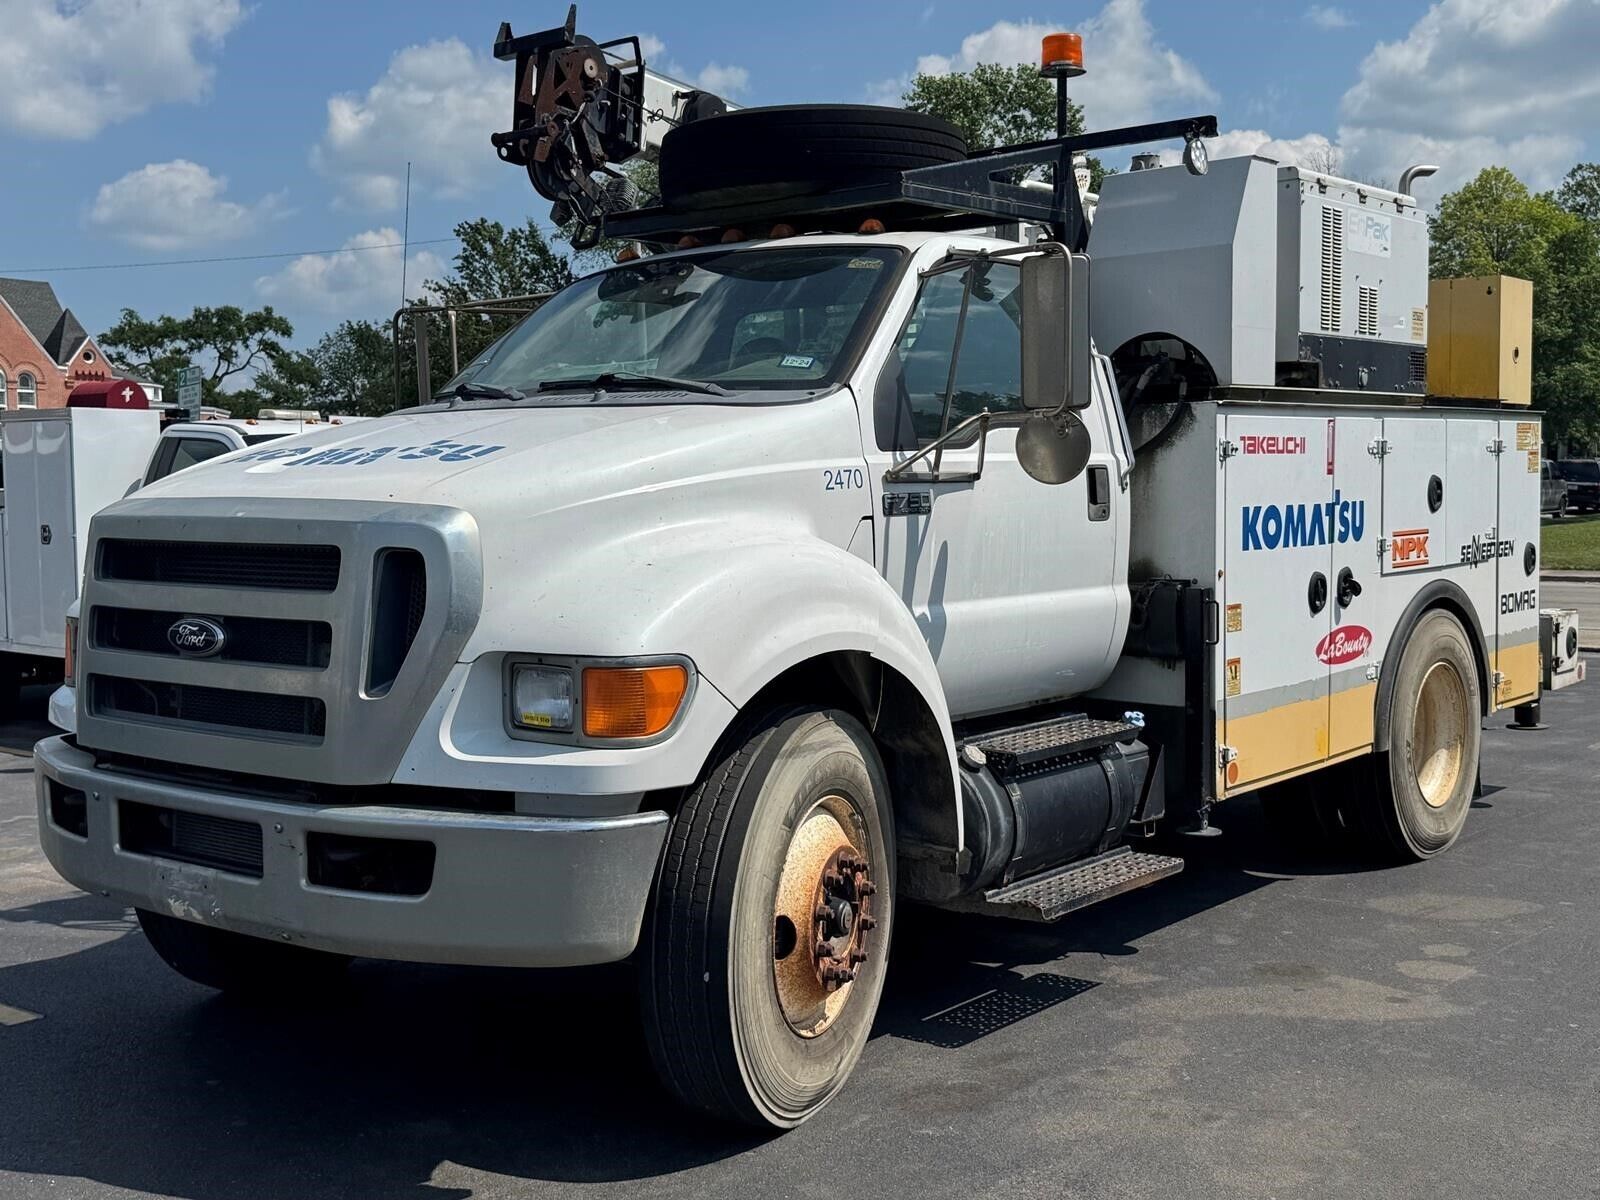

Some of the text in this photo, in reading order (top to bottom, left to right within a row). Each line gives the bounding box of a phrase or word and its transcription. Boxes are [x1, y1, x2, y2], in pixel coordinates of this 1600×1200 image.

[823, 468, 863, 491] 2470
[1242, 489, 1365, 551] KOMATSU
[1392, 536, 1429, 561] NPK
[1500, 589, 1536, 615] BOMAG
[176, 624, 207, 647] Ford
[1319, 632, 1369, 661] LaBounty
